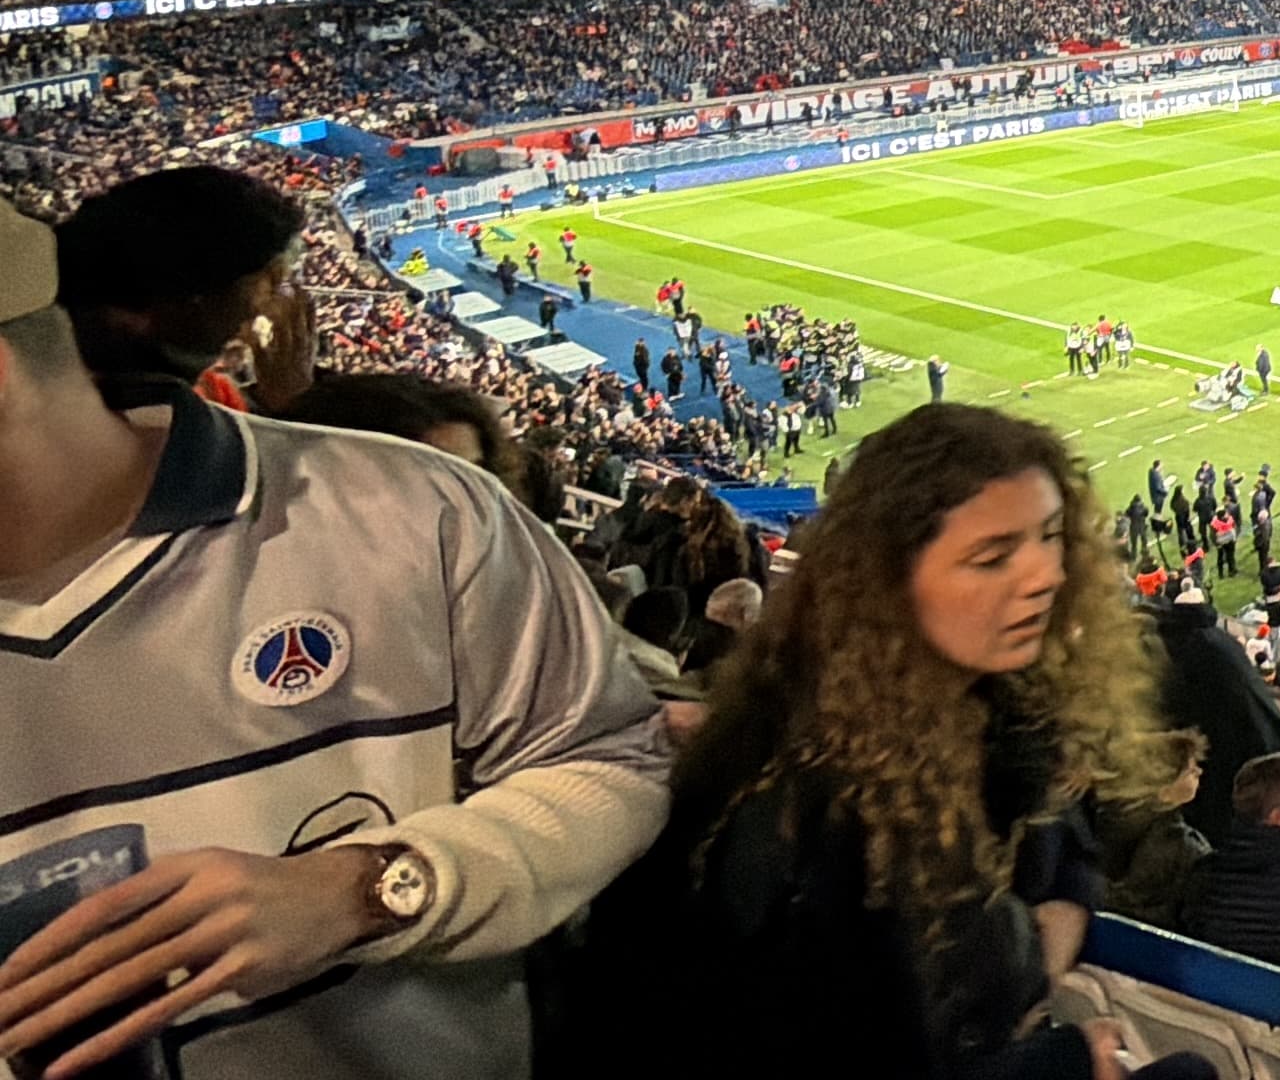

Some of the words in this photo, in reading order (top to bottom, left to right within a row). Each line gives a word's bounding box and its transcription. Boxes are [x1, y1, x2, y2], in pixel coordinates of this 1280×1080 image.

[841, 146, 879, 164] ICI
[889, 130, 966, 156] C'EST
[973, 117, 1045, 144] PARIS
